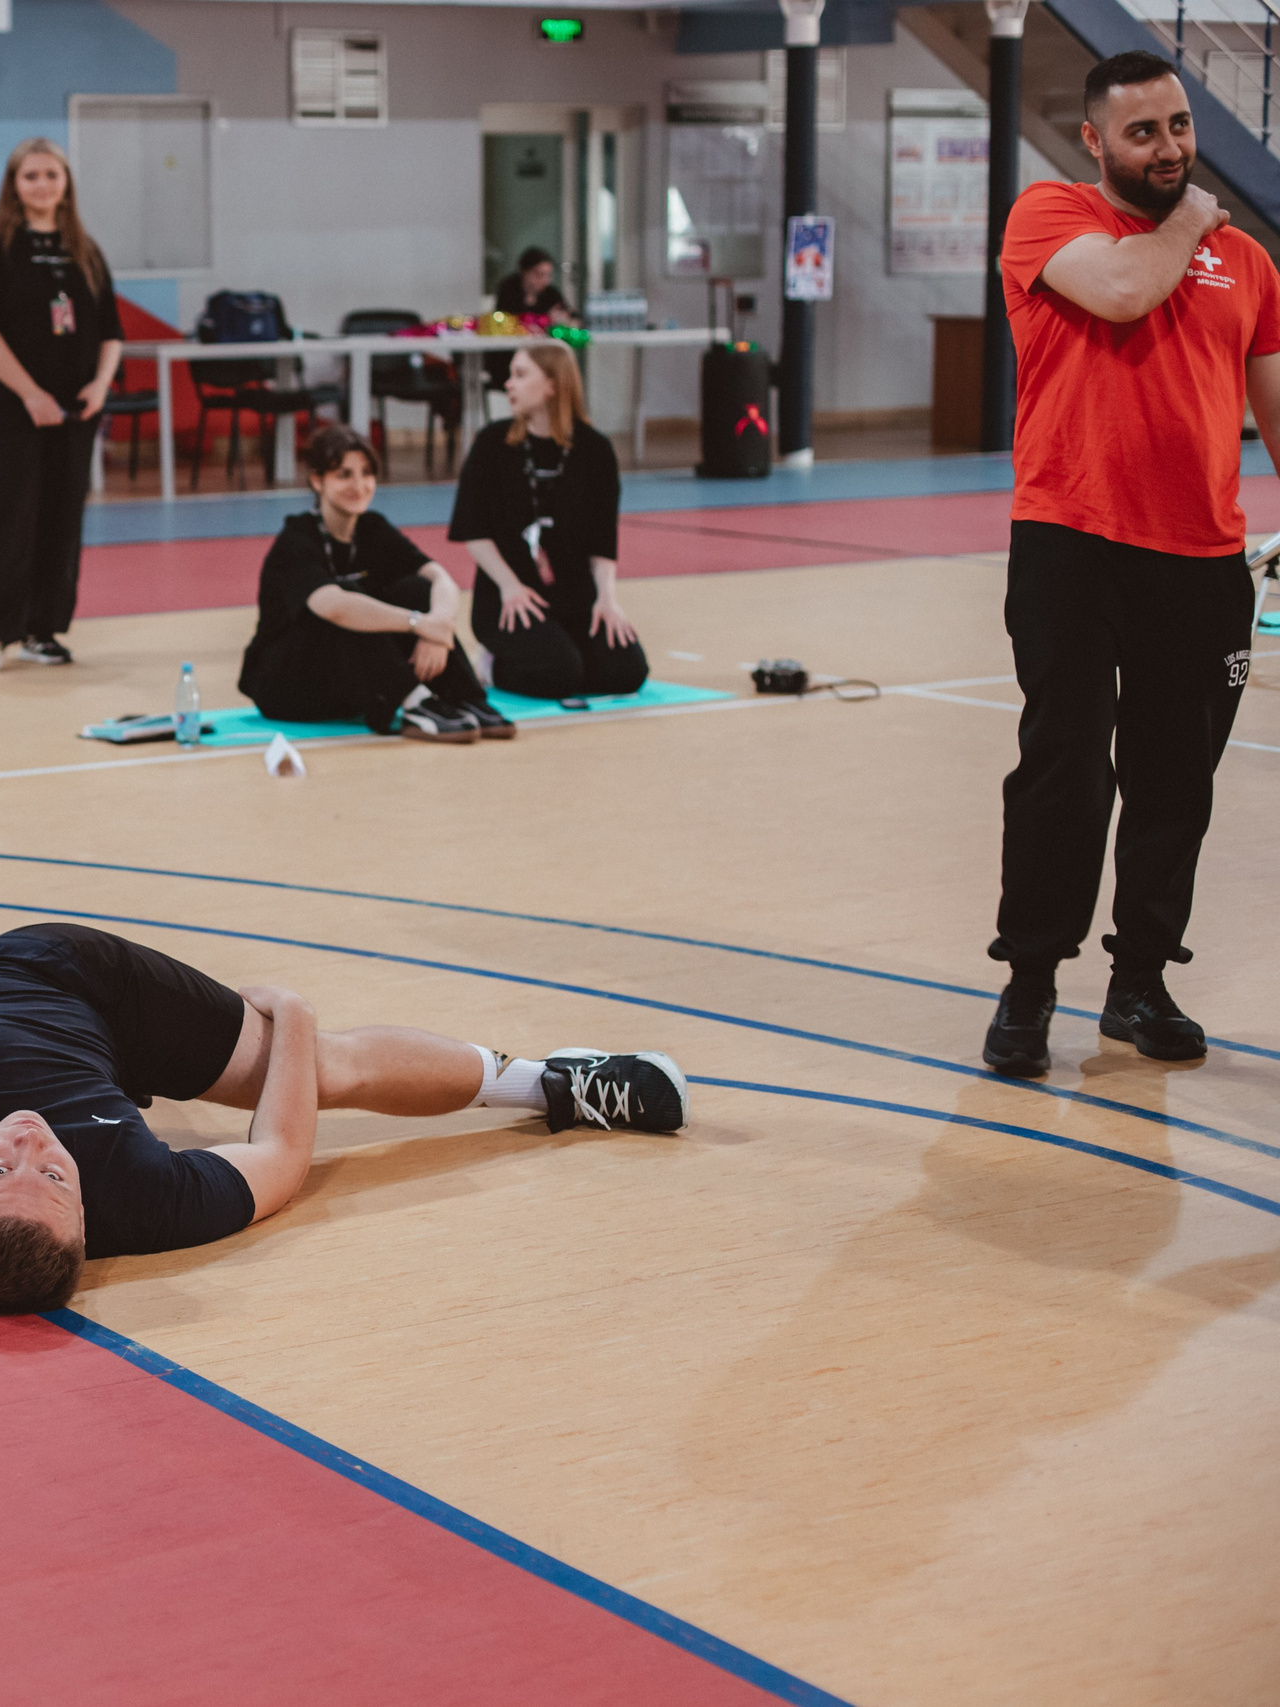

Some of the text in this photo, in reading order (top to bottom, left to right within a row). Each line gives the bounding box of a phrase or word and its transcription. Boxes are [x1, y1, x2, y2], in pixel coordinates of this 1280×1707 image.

[1197, 278, 1231, 290] медики
[1223, 653, 1236, 667] LOS
[1228, 661, 1248, 687] 92
